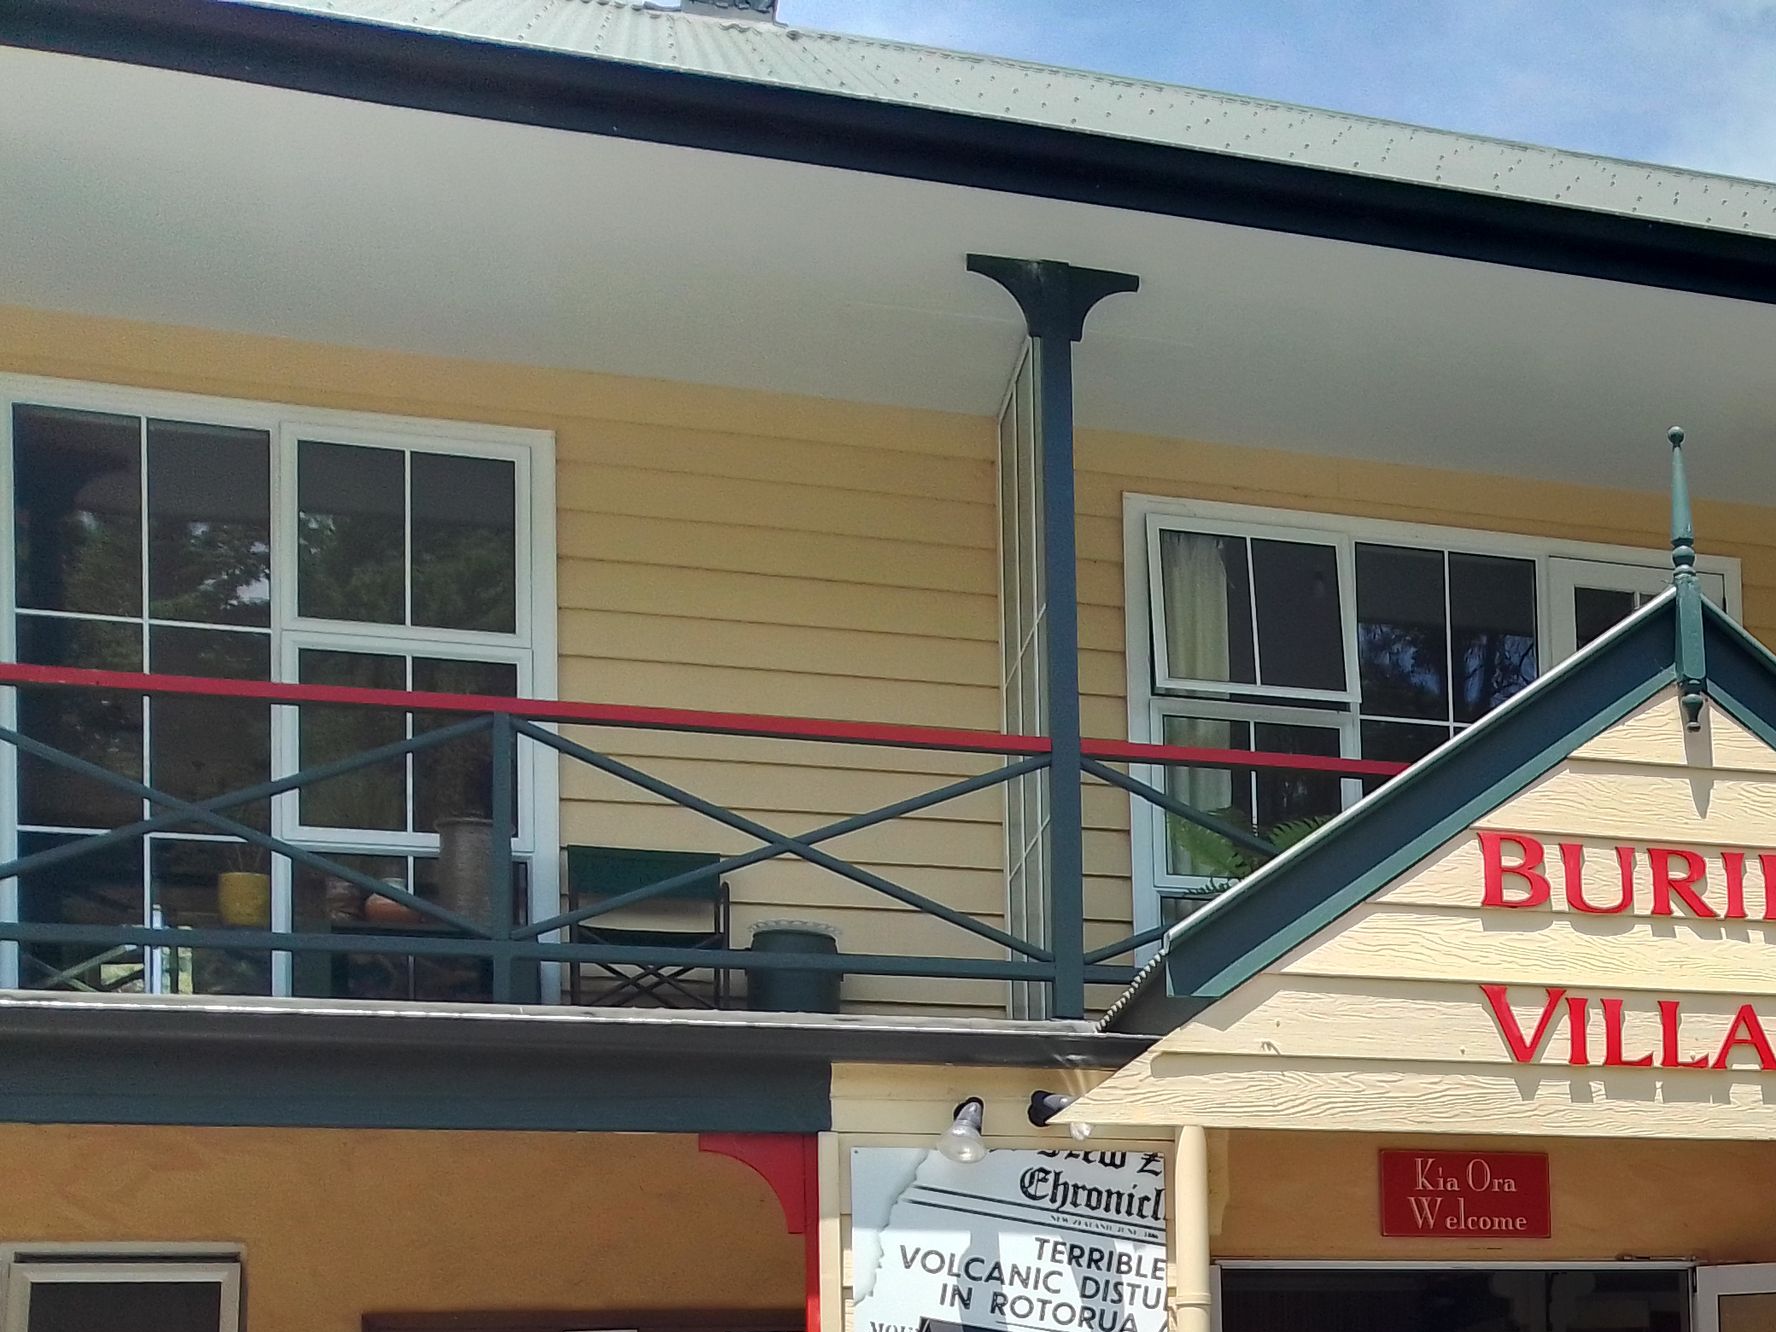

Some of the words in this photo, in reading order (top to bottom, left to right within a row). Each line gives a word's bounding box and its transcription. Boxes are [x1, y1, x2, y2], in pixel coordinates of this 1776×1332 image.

[1019, 1166, 1167, 1221] Chronicl
[1415, 1157, 1461, 1191] Kia
[1466, 1158, 1518, 1192] Ora
[1408, 1196, 1528, 1231] Welcome
[900, 1244, 1064, 1294] VOLCANIC
[1080, 1275, 1170, 1311] DISTU
[1034, 1236, 1166, 1281] TERRIBLE
[939, 1282, 973, 1311] IN
